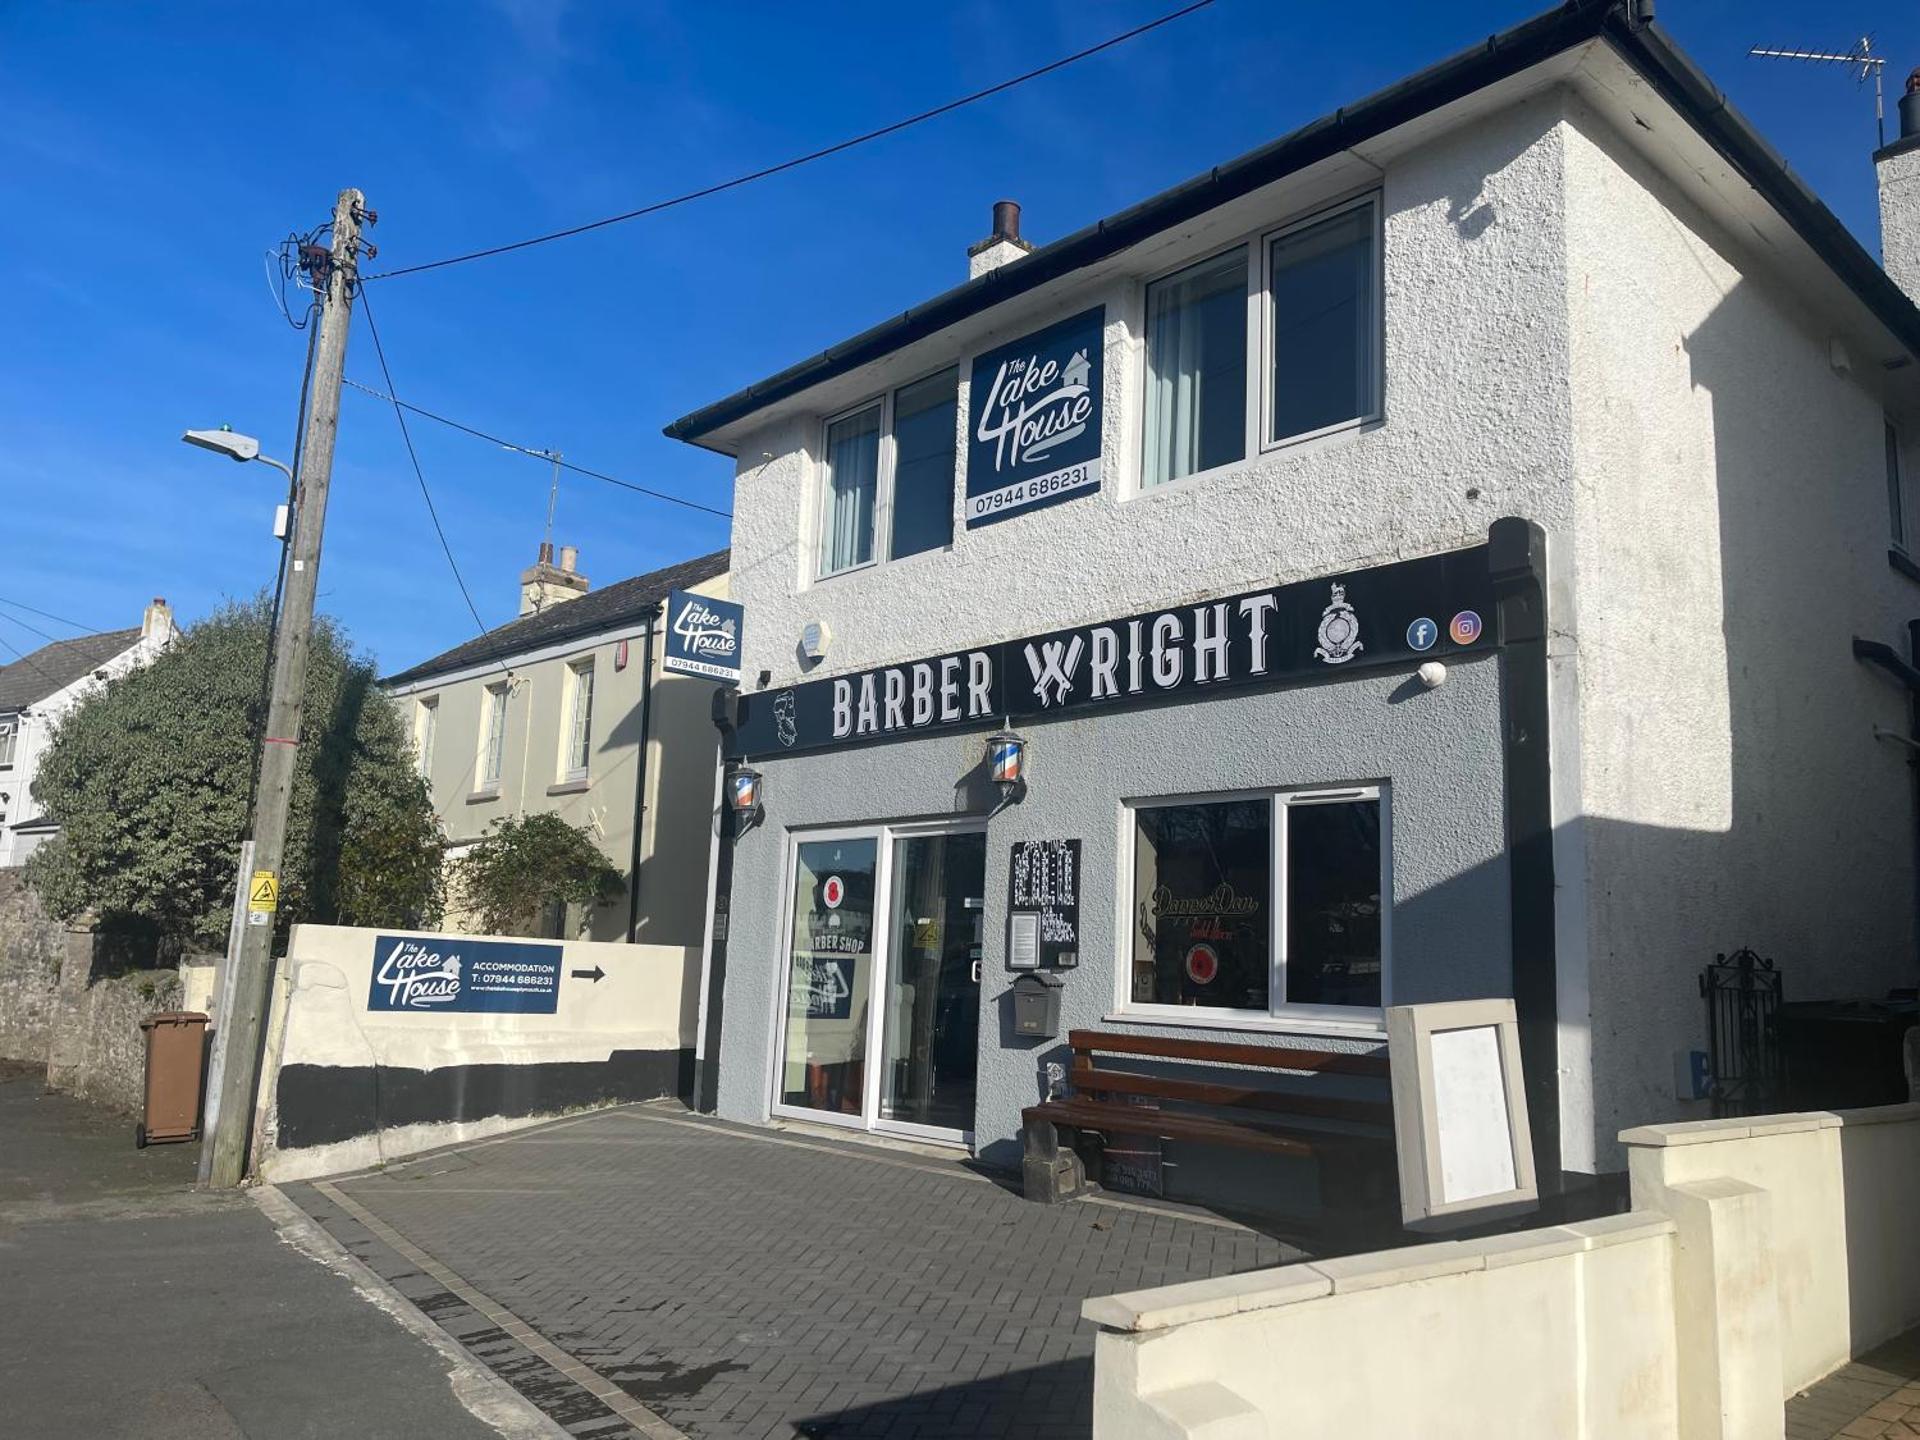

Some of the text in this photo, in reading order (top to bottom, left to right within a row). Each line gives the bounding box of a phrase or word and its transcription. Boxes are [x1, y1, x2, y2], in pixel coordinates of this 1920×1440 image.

[1007, 358, 1026, 377] The
[995, 393, 1093, 472] House
[975, 466, 1089, 514] 07944 686231
[683, 623, 737, 655] House
[671, 659, 734, 678] 07944 686231
[831, 593, 1279, 740] BARBER WRIGHT
[404, 943, 418, 953] The
[839, 936, 865, 953] SHOP
[472, 962, 555, 974] ACCOMMODATION
[390, 969, 461, 1006] House
[471, 973, 553, 986] T: 07944 686231
